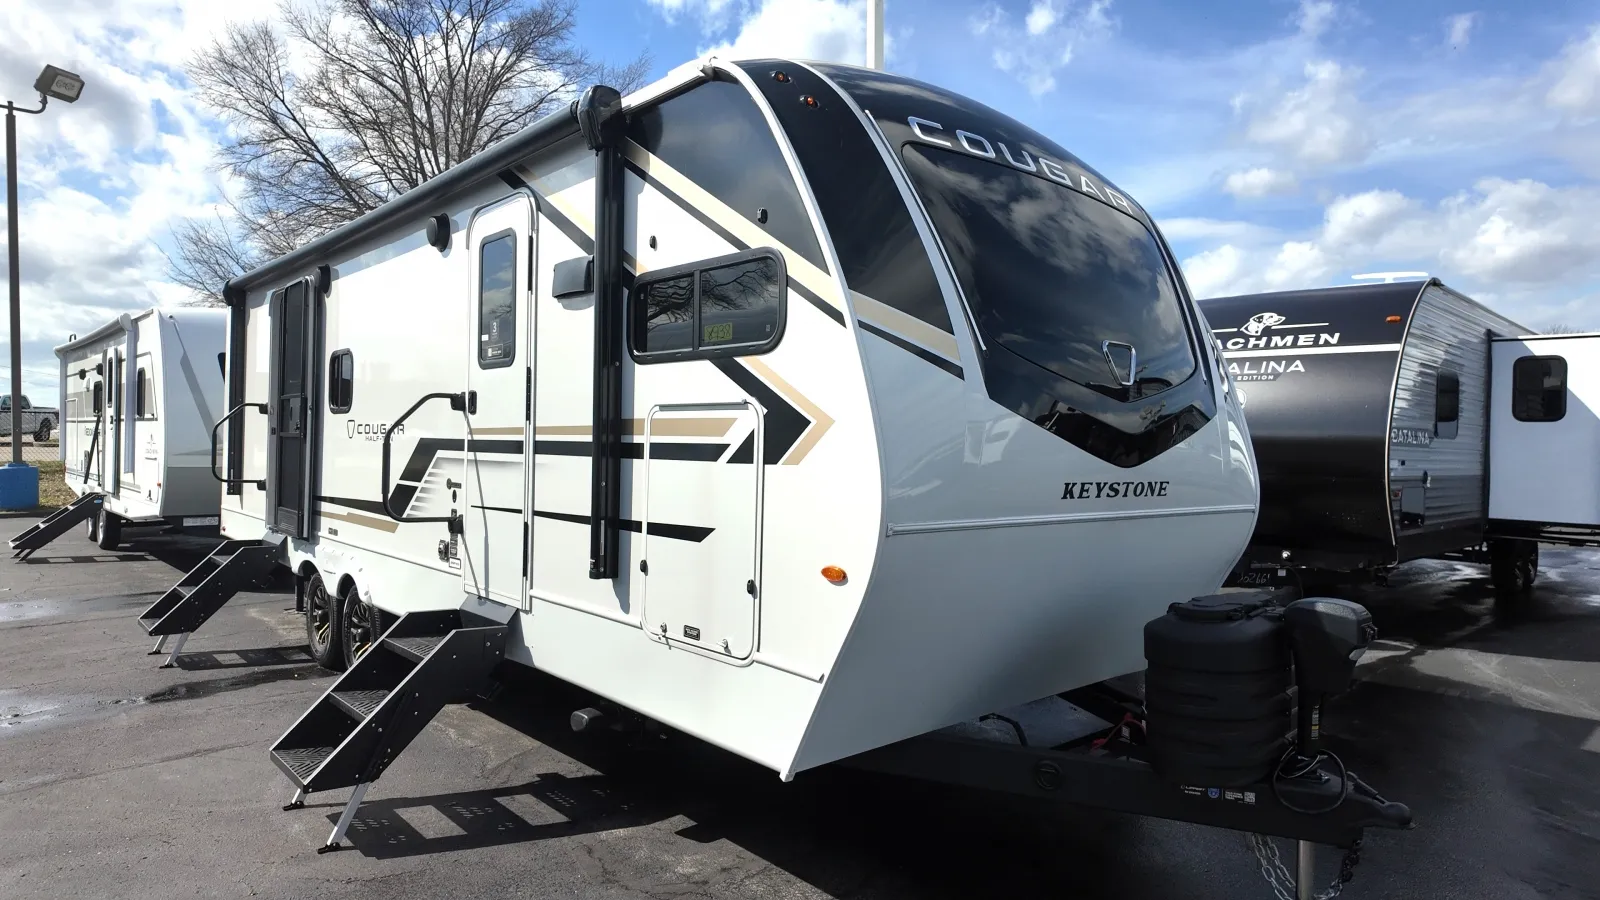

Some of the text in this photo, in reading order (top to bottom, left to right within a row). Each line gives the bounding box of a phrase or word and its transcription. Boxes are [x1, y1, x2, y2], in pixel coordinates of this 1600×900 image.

[907, 116, 1134, 215] COUGAR
[1217, 332, 1341, 350] CHMEN
[1228, 359, 1306, 374] ALINA
[1390, 428, 1430, 445] CATALINA
[1060, 481, 1170, 500] KEYSTONE
